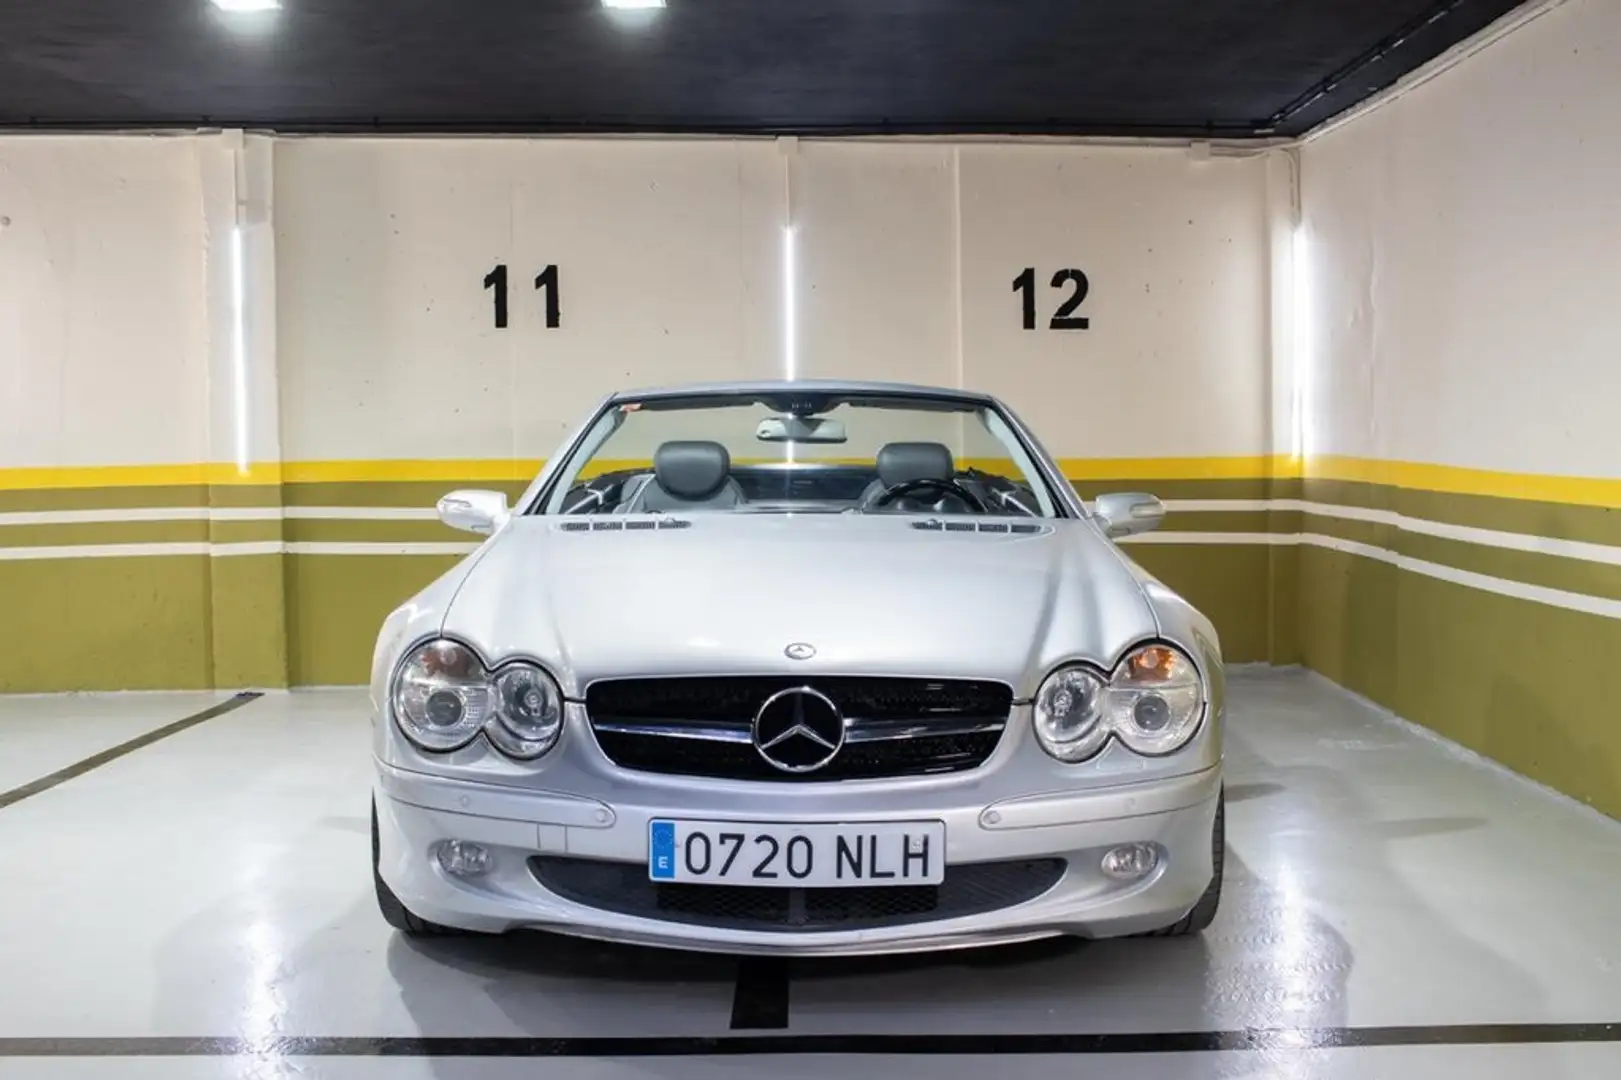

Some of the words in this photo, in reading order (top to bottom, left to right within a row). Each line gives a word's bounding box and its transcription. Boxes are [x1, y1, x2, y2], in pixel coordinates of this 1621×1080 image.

[483, 264, 560, 329] 11
[1012, 267, 1089, 330] 12
[658, 855, 668, 869] E
[685, 831, 813, 879] 0720
[836, 834, 929, 879] NLH
